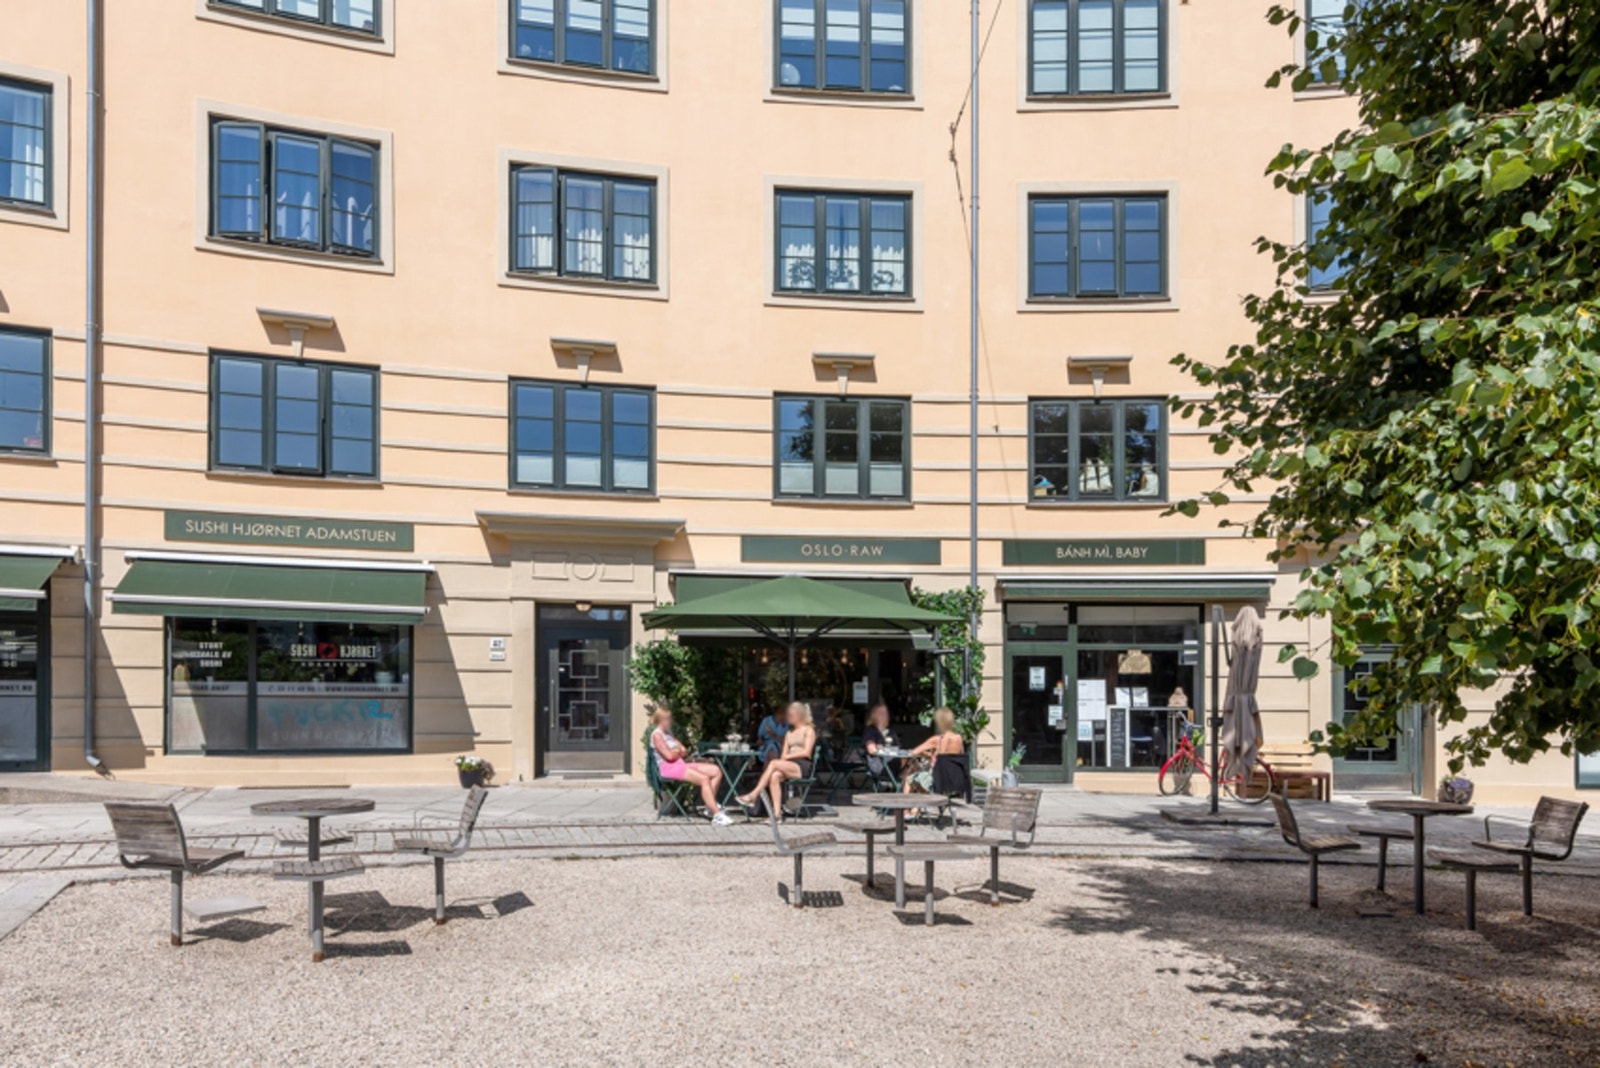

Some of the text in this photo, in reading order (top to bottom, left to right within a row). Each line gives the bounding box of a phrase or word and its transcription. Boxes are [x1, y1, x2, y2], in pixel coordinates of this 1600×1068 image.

[185, 519, 397, 543] SUSHI HJØRNET ADAMSTUEN
[801, 543, 884, 557] OSLO RAW
[1056, 544, 1091, 559] BÁNH
[1115, 546, 1149, 559] BABY
[290, 643, 317, 657] SUSHI
